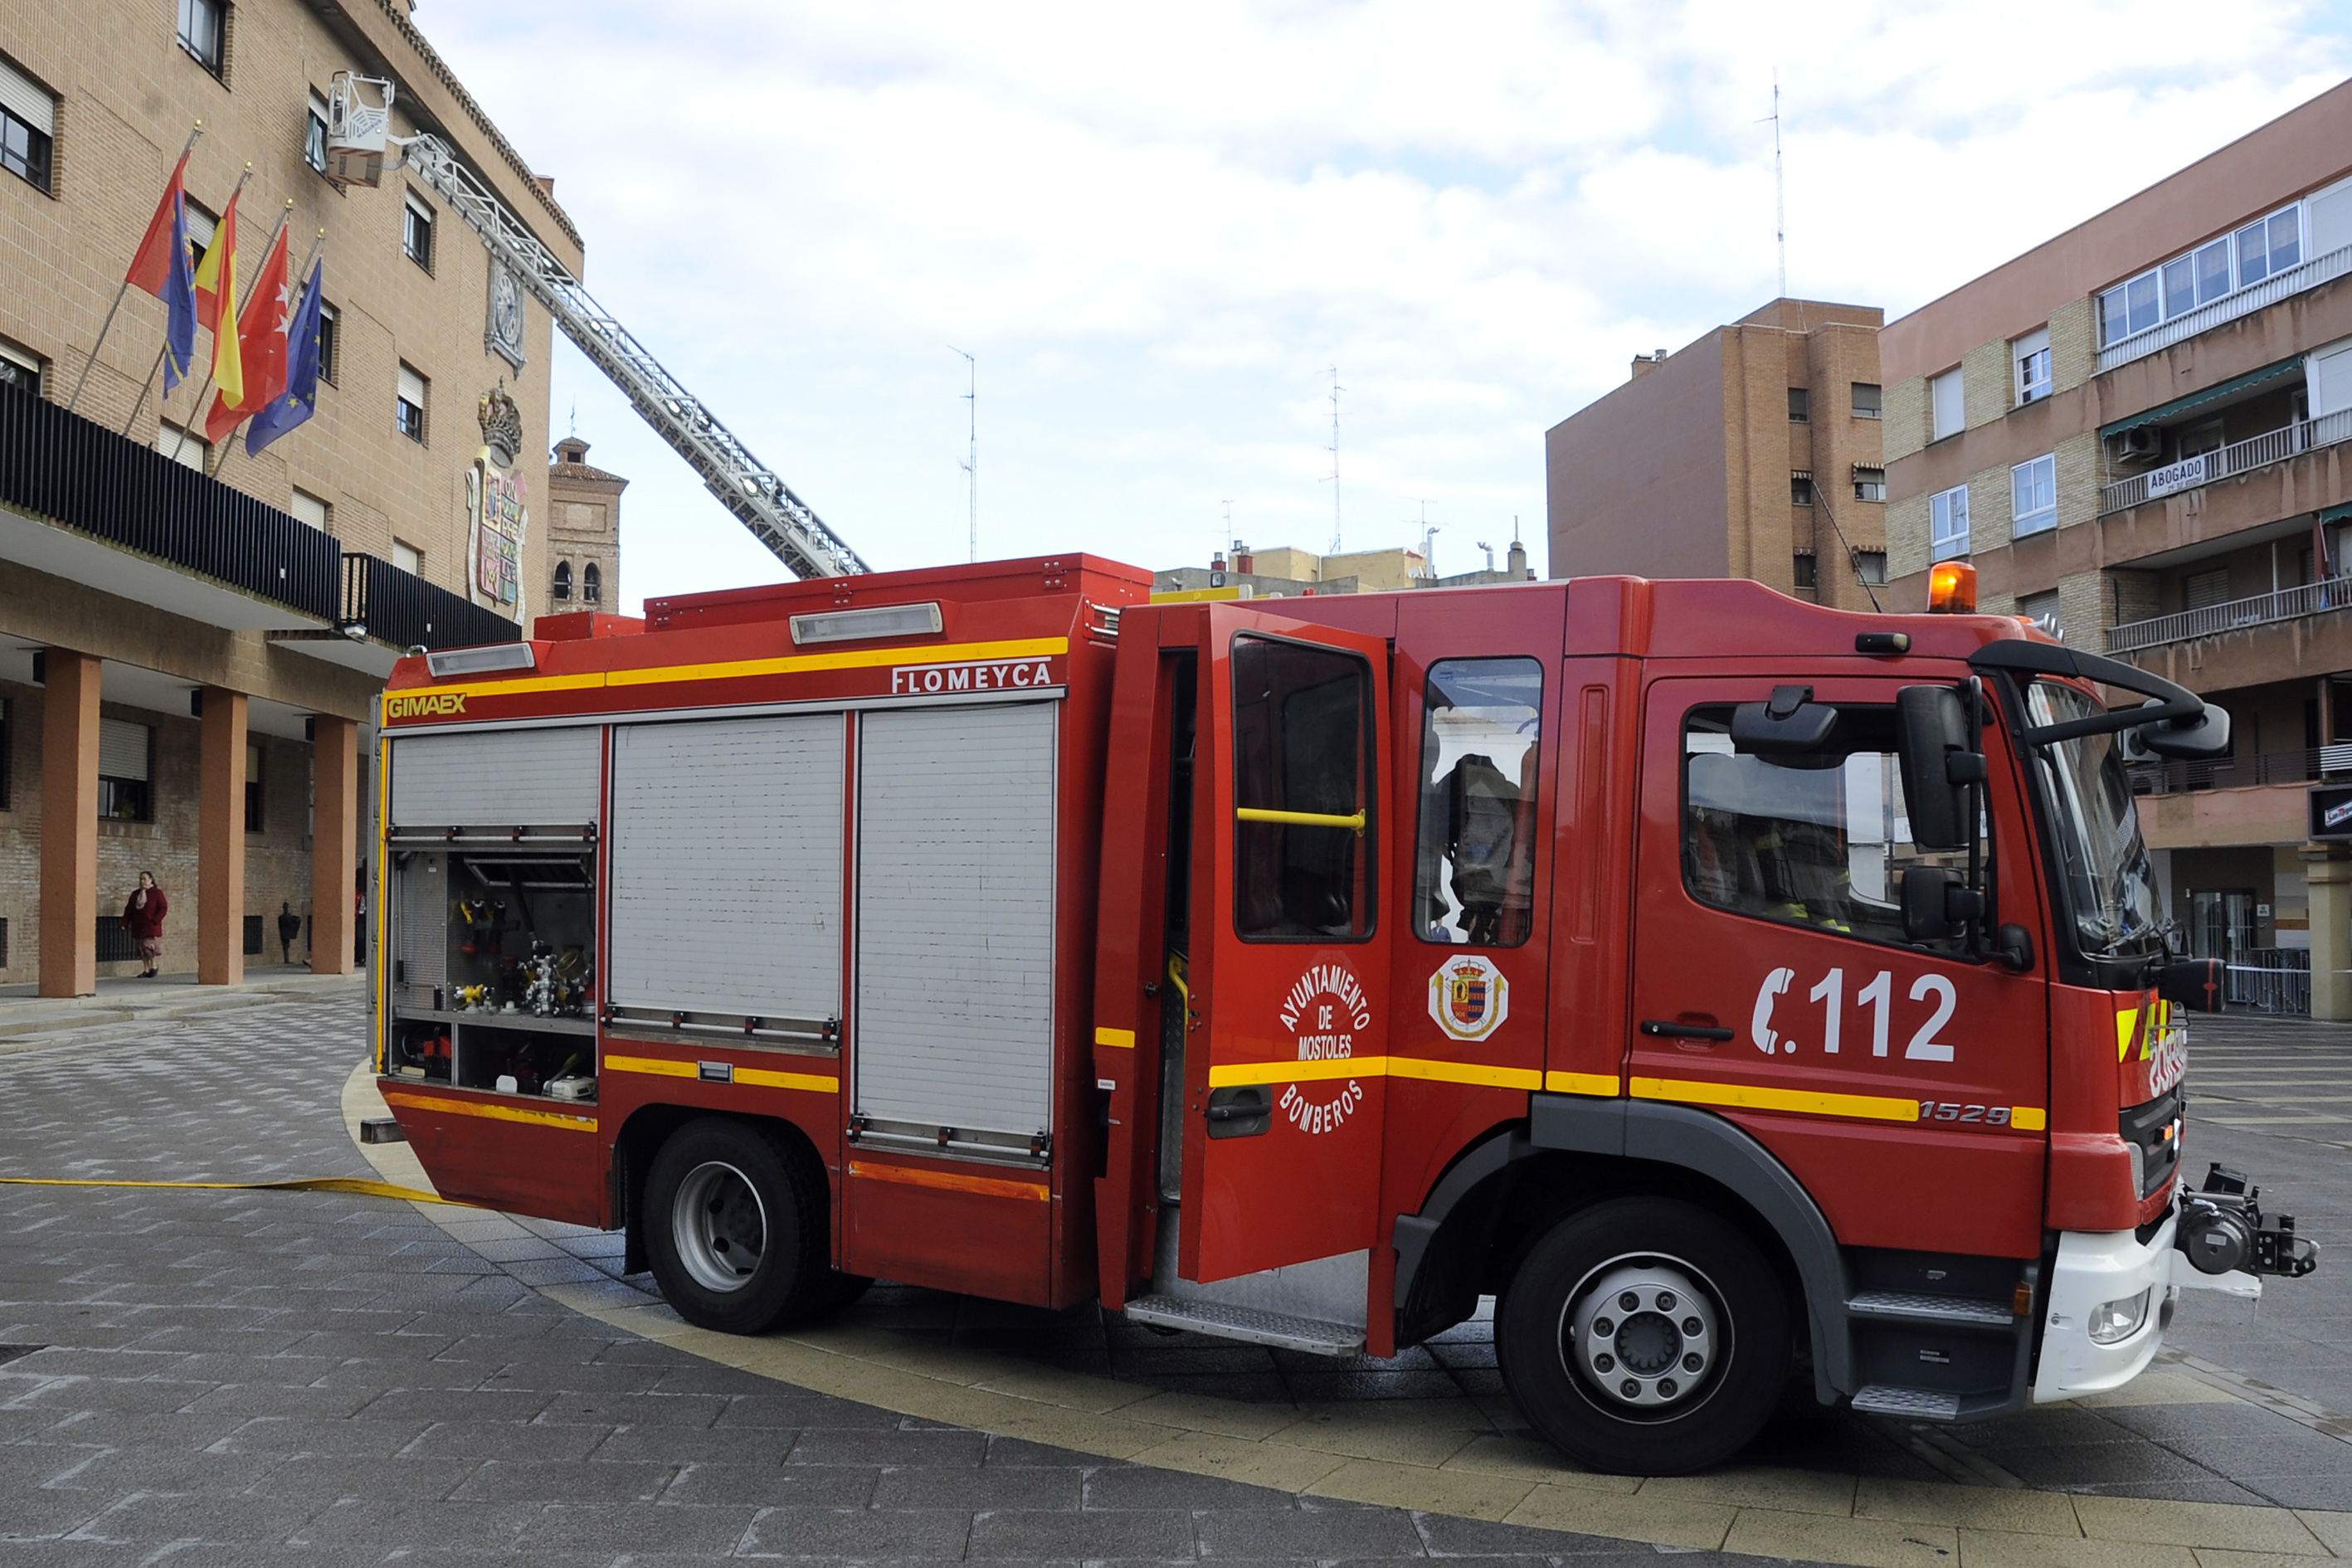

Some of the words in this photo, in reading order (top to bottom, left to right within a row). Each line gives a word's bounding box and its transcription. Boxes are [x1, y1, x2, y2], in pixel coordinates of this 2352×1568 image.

[2151, 460, 2202, 489] ABOGADO
[892, 656, 1052, 694] FLOMEYCA
[388, 694, 466, 718] GIMAEX
[1279, 964, 1371, 1032] AYUNTAMIENTO
[1317, 1005, 1333, 1030] DE
[1809, 967, 1956, 1062] 112
[1298, 1035, 1351, 1060] MOSTOLES
[1279, 1079, 1363, 1134] BOMBEROS
[1919, 1101, 2012, 1125] 1529
